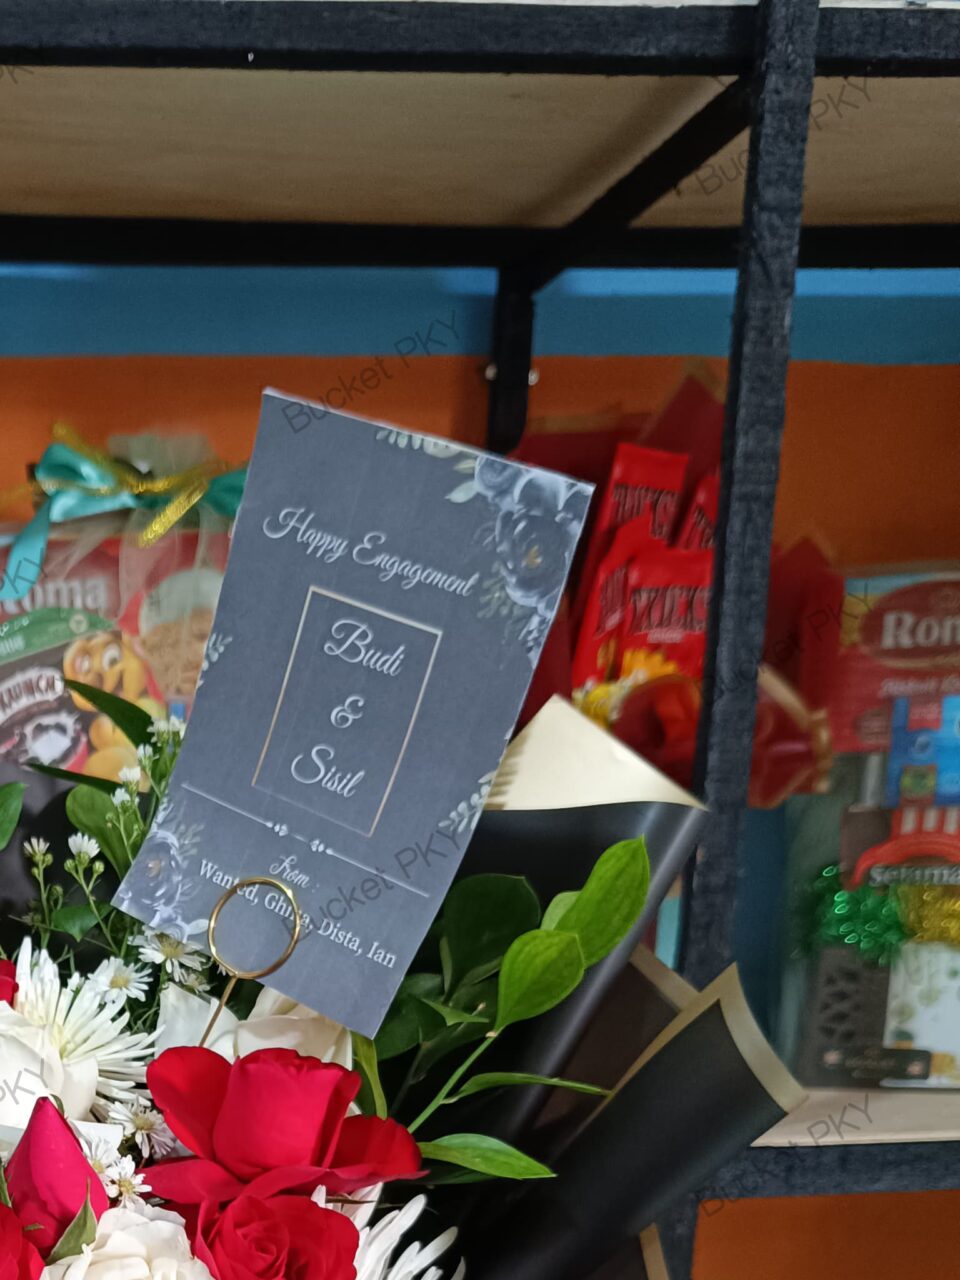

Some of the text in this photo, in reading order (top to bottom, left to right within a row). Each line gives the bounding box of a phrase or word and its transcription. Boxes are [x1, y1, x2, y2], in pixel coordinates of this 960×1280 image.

[262, 507, 480, 597] Happy Engagement
[324, 619, 405, 676] Budi
[330, 695, 364, 728] &
[291, 744, 365, 797] Sisil
[264, 892, 313, 933] Ghia,
[318, 917, 363, 956] Dista,
[366, 941, 397, 968] Ian
